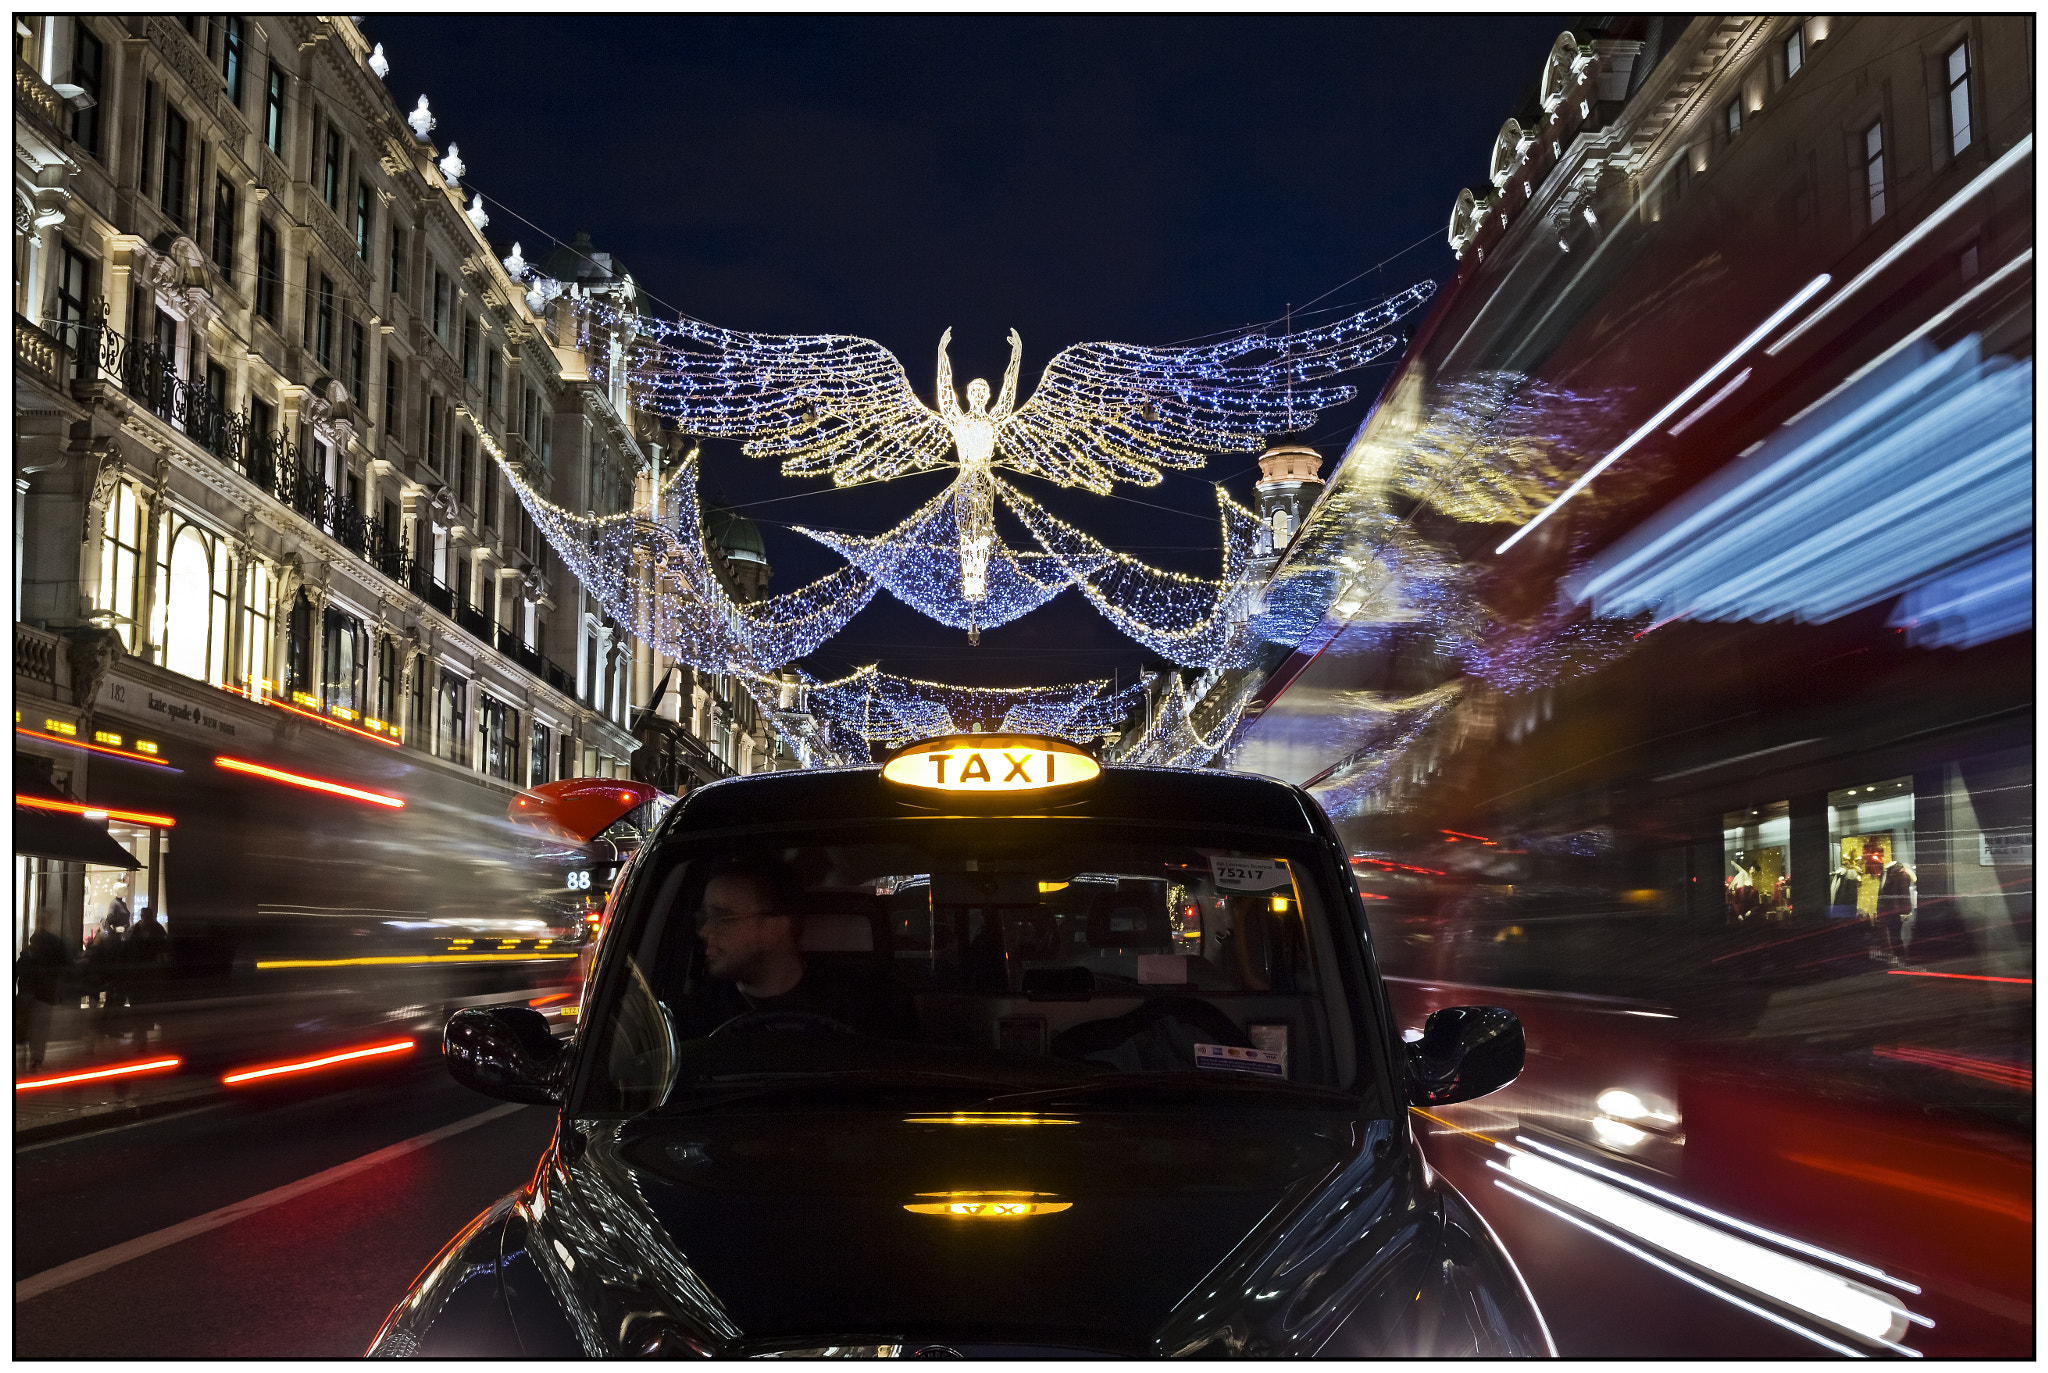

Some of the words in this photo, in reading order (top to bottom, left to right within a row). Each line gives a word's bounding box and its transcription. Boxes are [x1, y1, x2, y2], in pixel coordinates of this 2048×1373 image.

[111, 683, 125, 703] 182
[928, 753, 1055, 784] TAXI
[567, 871, 591, 890] 88
[1217, 867, 1264, 880] 75217
